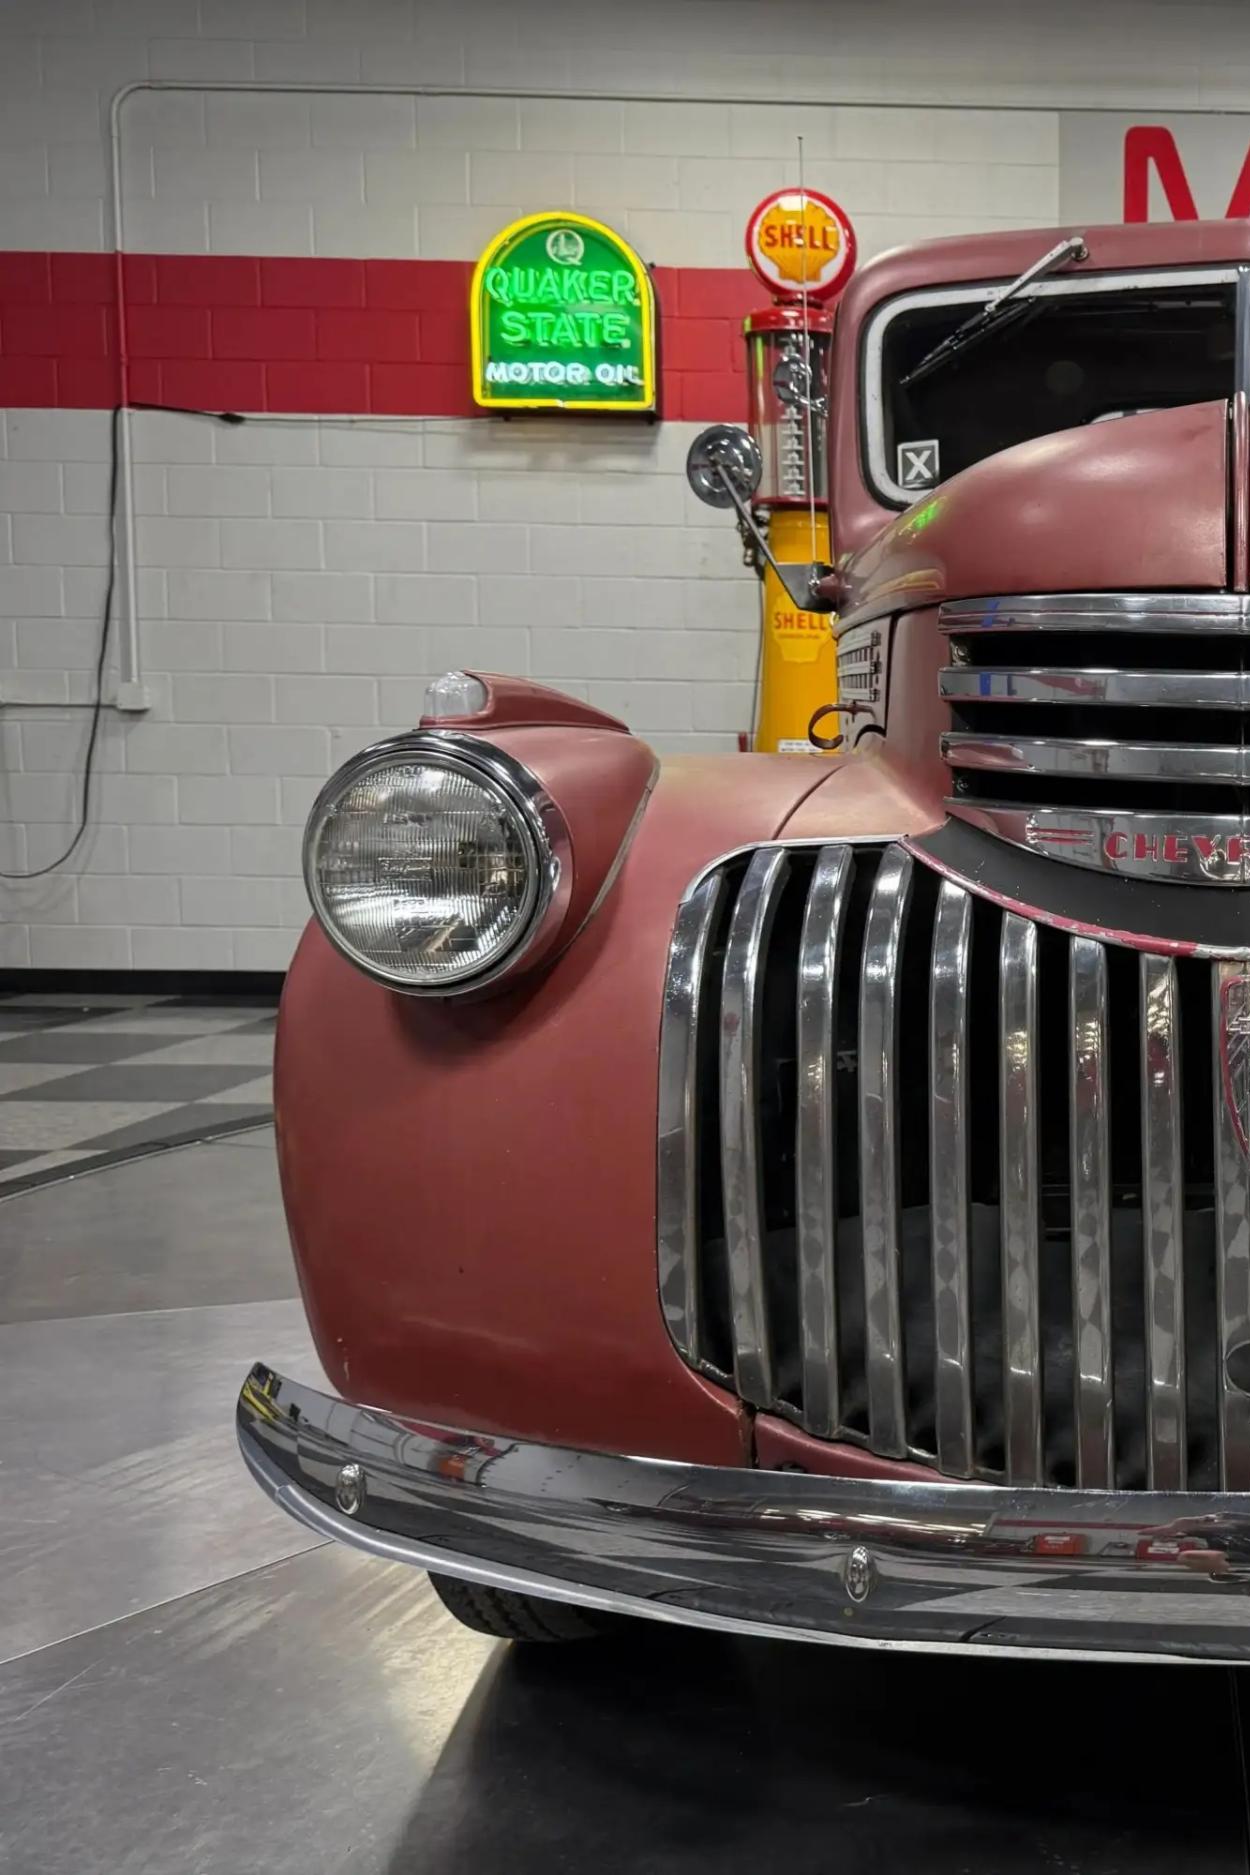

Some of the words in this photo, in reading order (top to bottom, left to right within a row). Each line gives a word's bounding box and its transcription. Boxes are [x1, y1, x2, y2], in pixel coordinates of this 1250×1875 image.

[764, 223, 837, 251] SHELL
[485, 266, 641, 308] QUAKER
[500, 310, 632, 348] STATE
[485, 361, 592, 386] MOTOR
[594, 363, 646, 387] OIL
[905, 450, 934, 481] X
[774, 611, 828, 631] SHELL
